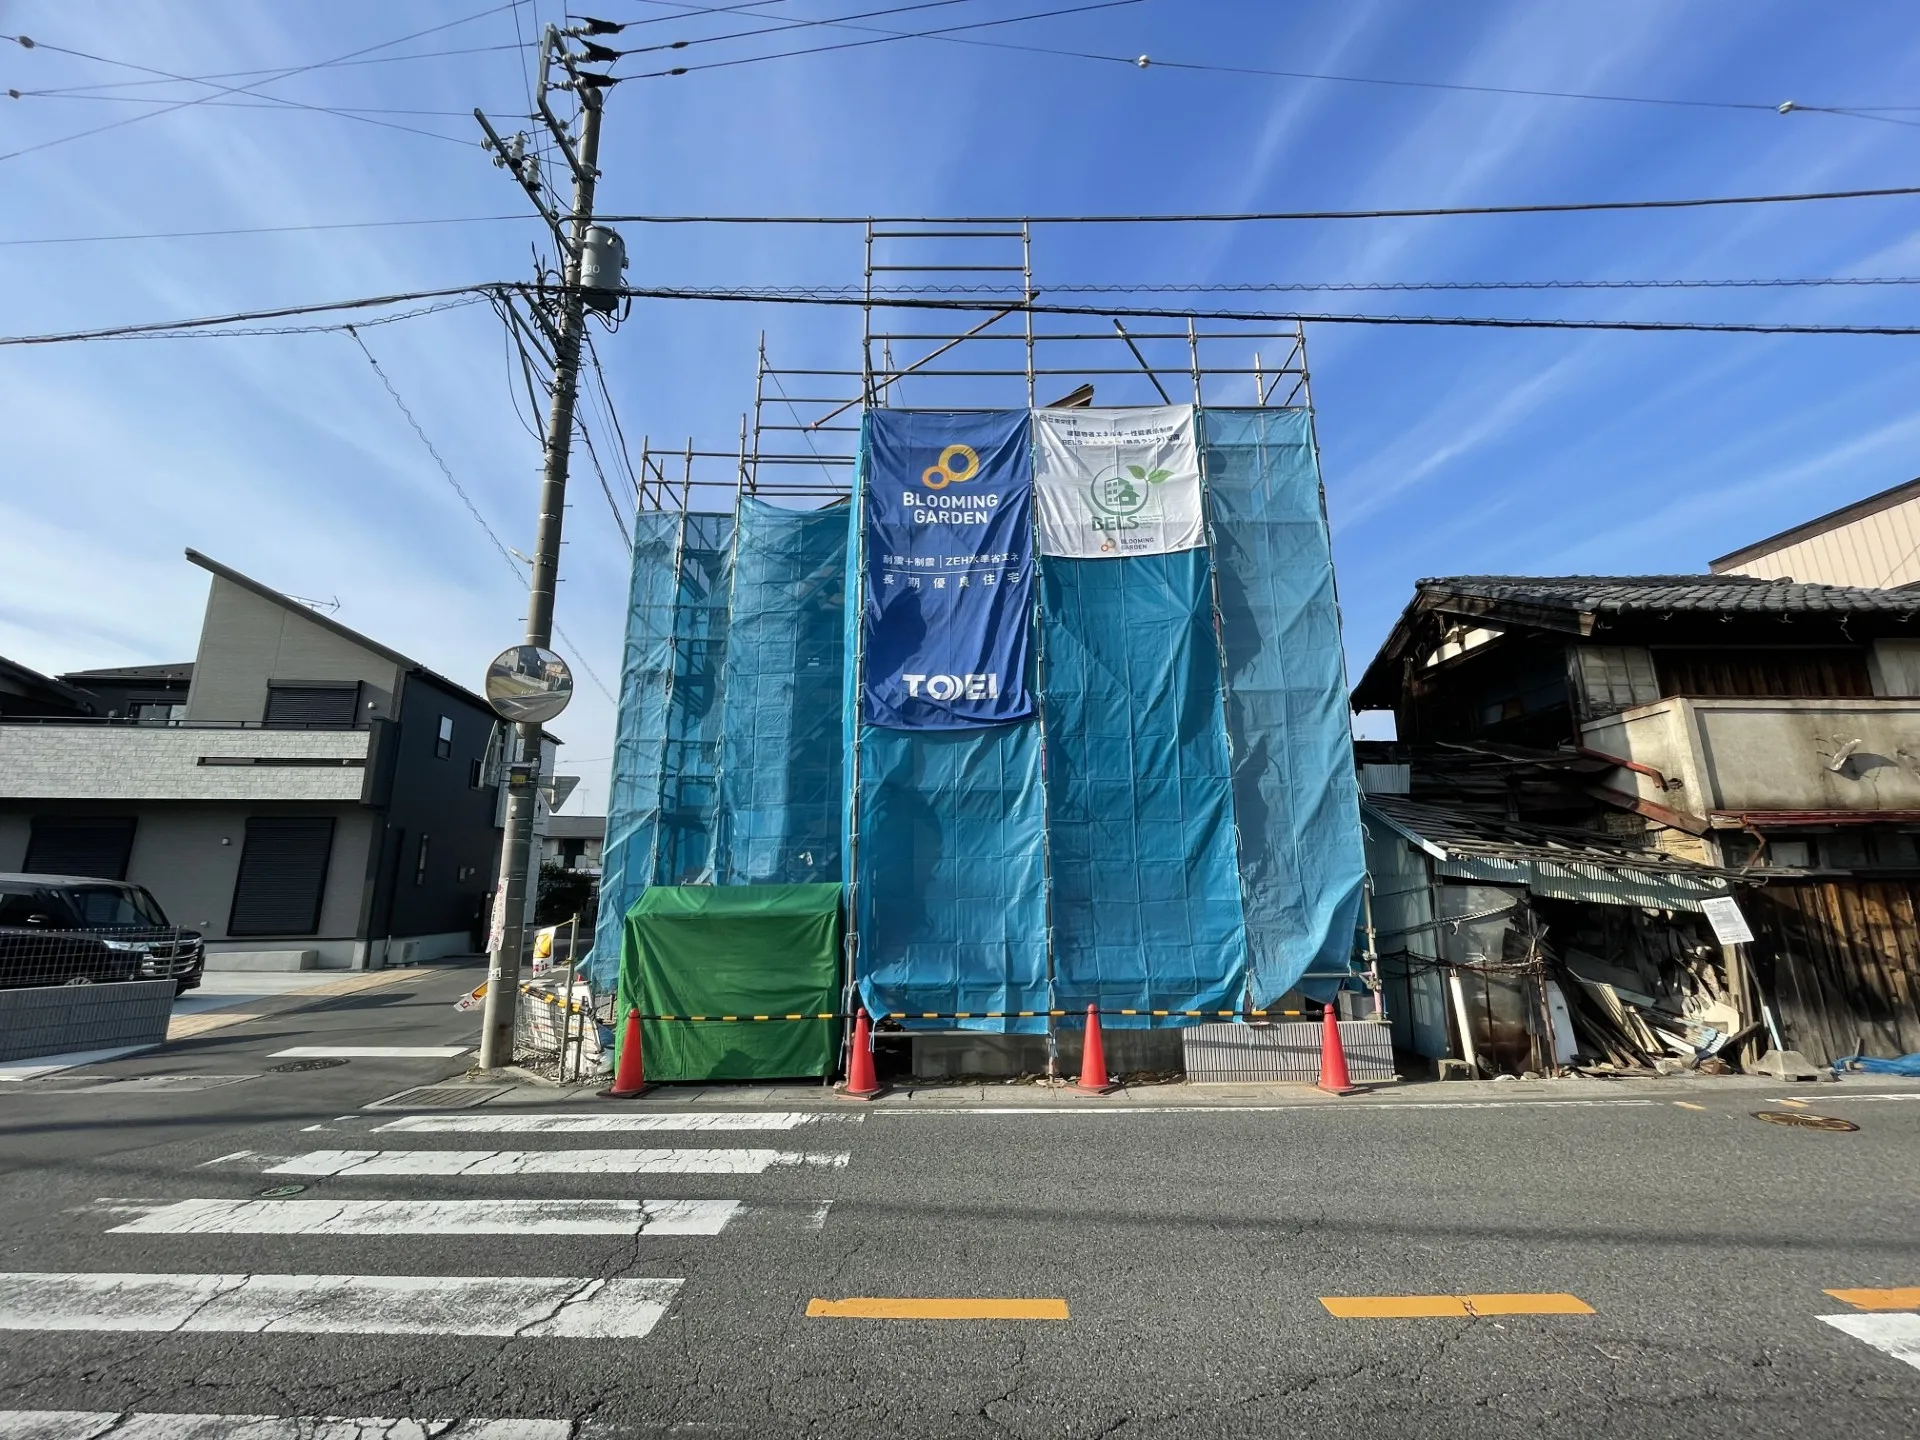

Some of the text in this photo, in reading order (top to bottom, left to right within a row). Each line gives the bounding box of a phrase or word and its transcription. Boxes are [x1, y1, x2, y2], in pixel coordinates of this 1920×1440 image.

[903, 491, 998, 509] BLOOMING
[913, 509, 988, 525] GARDEN
[1092, 515, 1139, 531] BELS
[883, 572, 1020, 588] 長期優良住宅
[902, 673, 998, 701] TOEI
